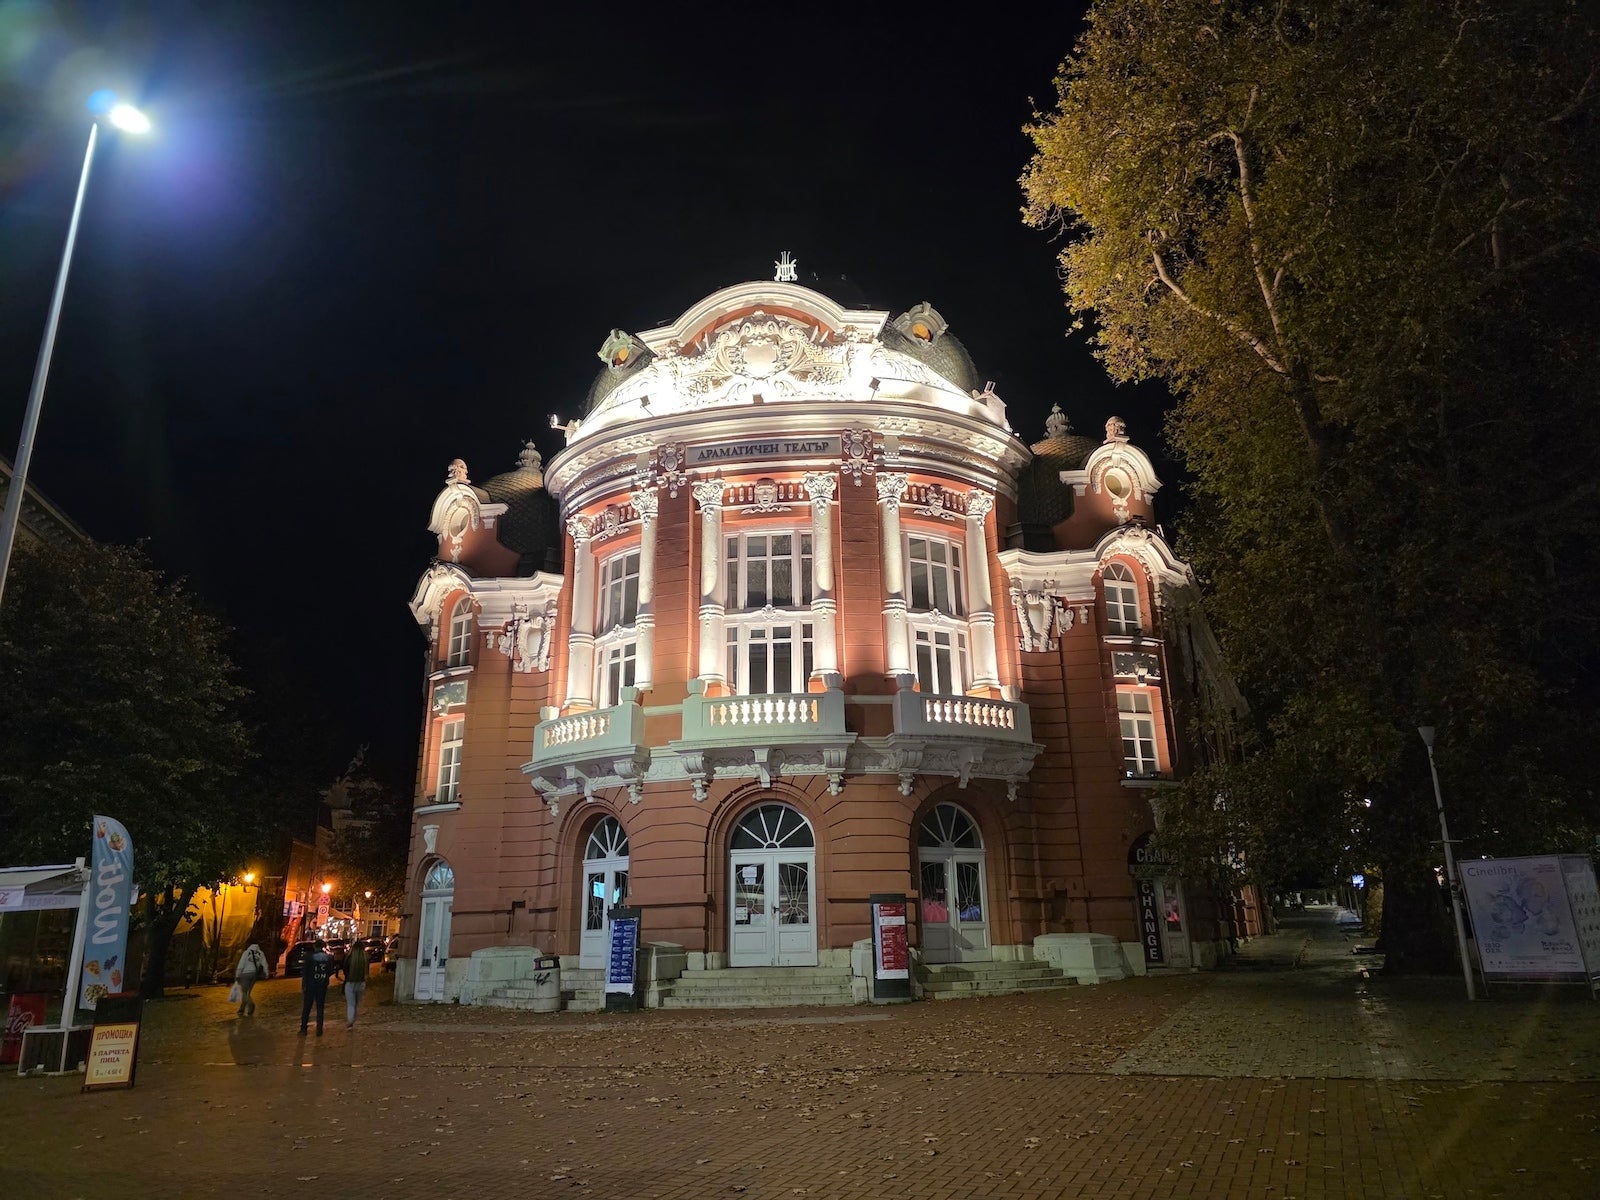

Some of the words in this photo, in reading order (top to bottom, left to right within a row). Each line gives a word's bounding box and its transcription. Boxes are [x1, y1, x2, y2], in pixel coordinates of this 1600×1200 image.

[697, 444, 779, 460] ДРАМАТИЧЕН
[784, 441, 829, 454] ТЕАТЪР
[1467, 866, 1517, 877] Cinelibri
[1141, 883, 1158, 960] CHANGE
[96, 1029, 133, 1041] ПРОМОЦИЯ
